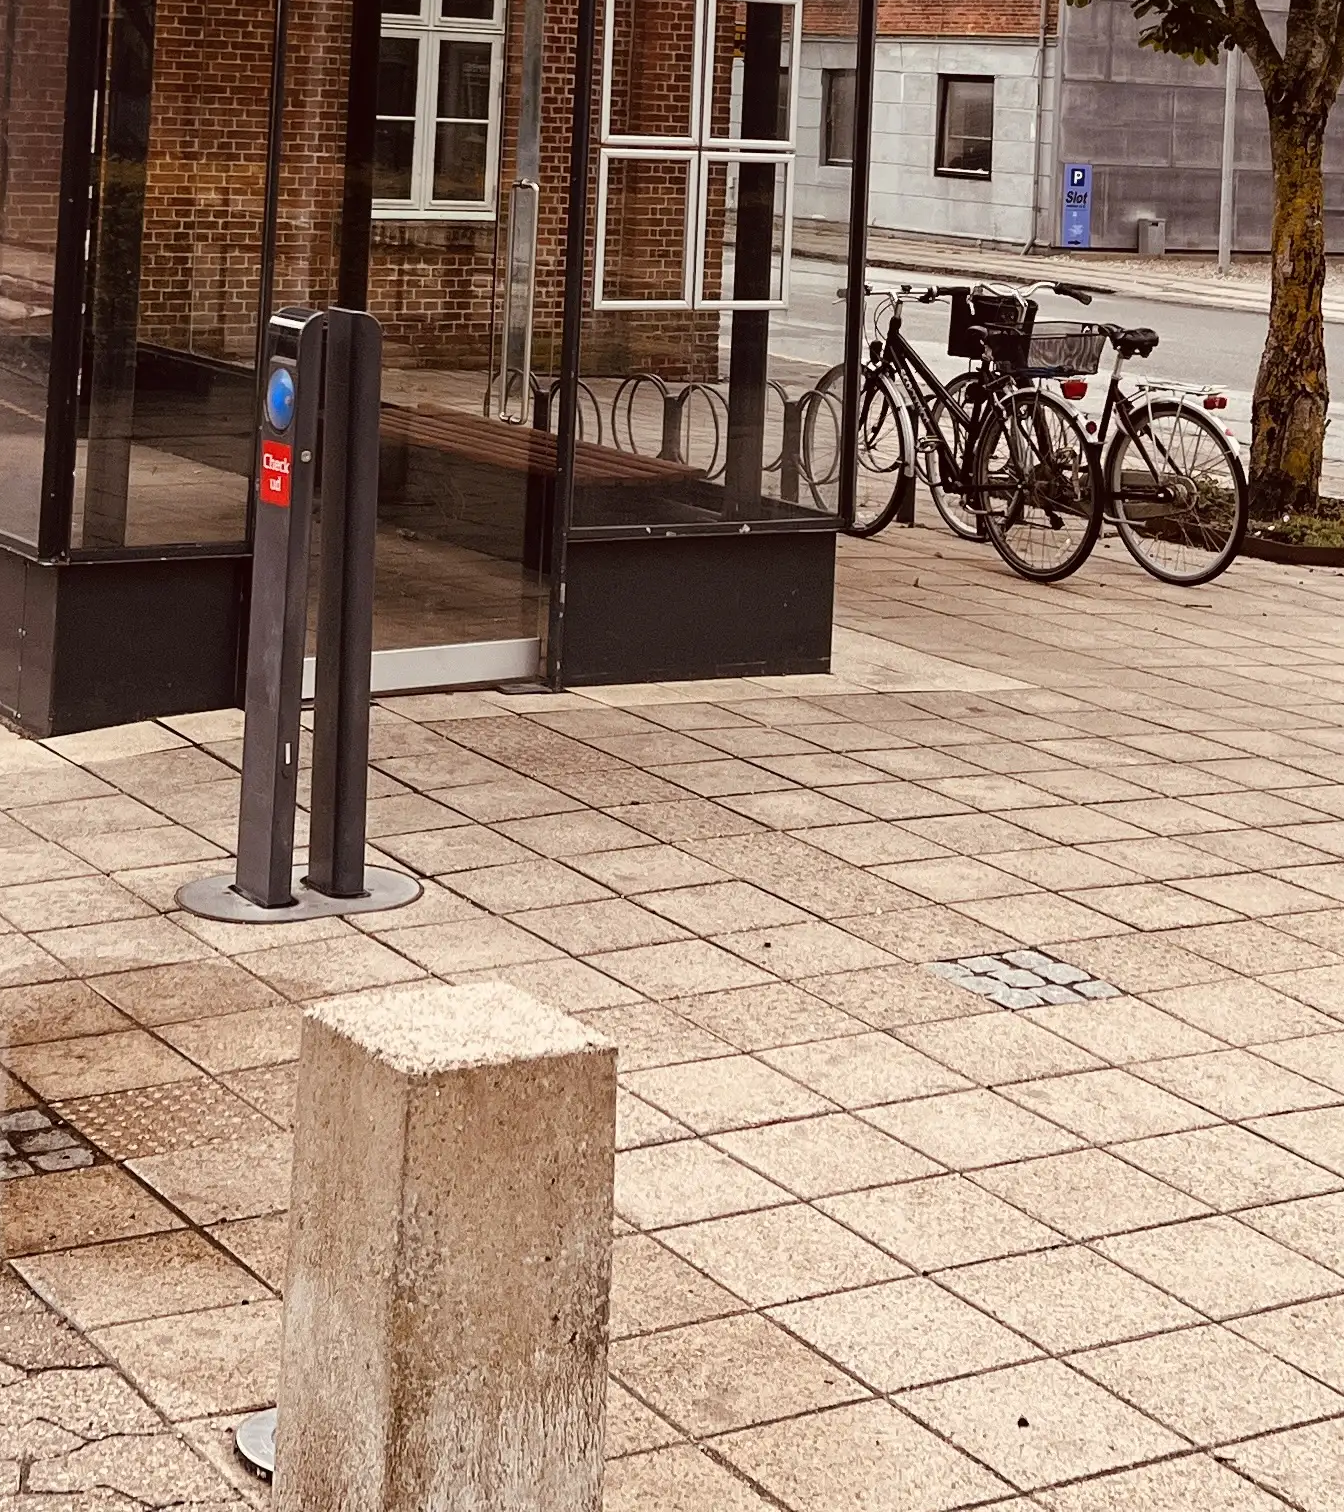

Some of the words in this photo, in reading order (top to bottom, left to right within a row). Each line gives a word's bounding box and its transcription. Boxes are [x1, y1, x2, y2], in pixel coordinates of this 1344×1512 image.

[1073, 170, 1083, 185] P
[1065, 190, 1088, 204] Slot
[262, 452, 290, 475] Check
